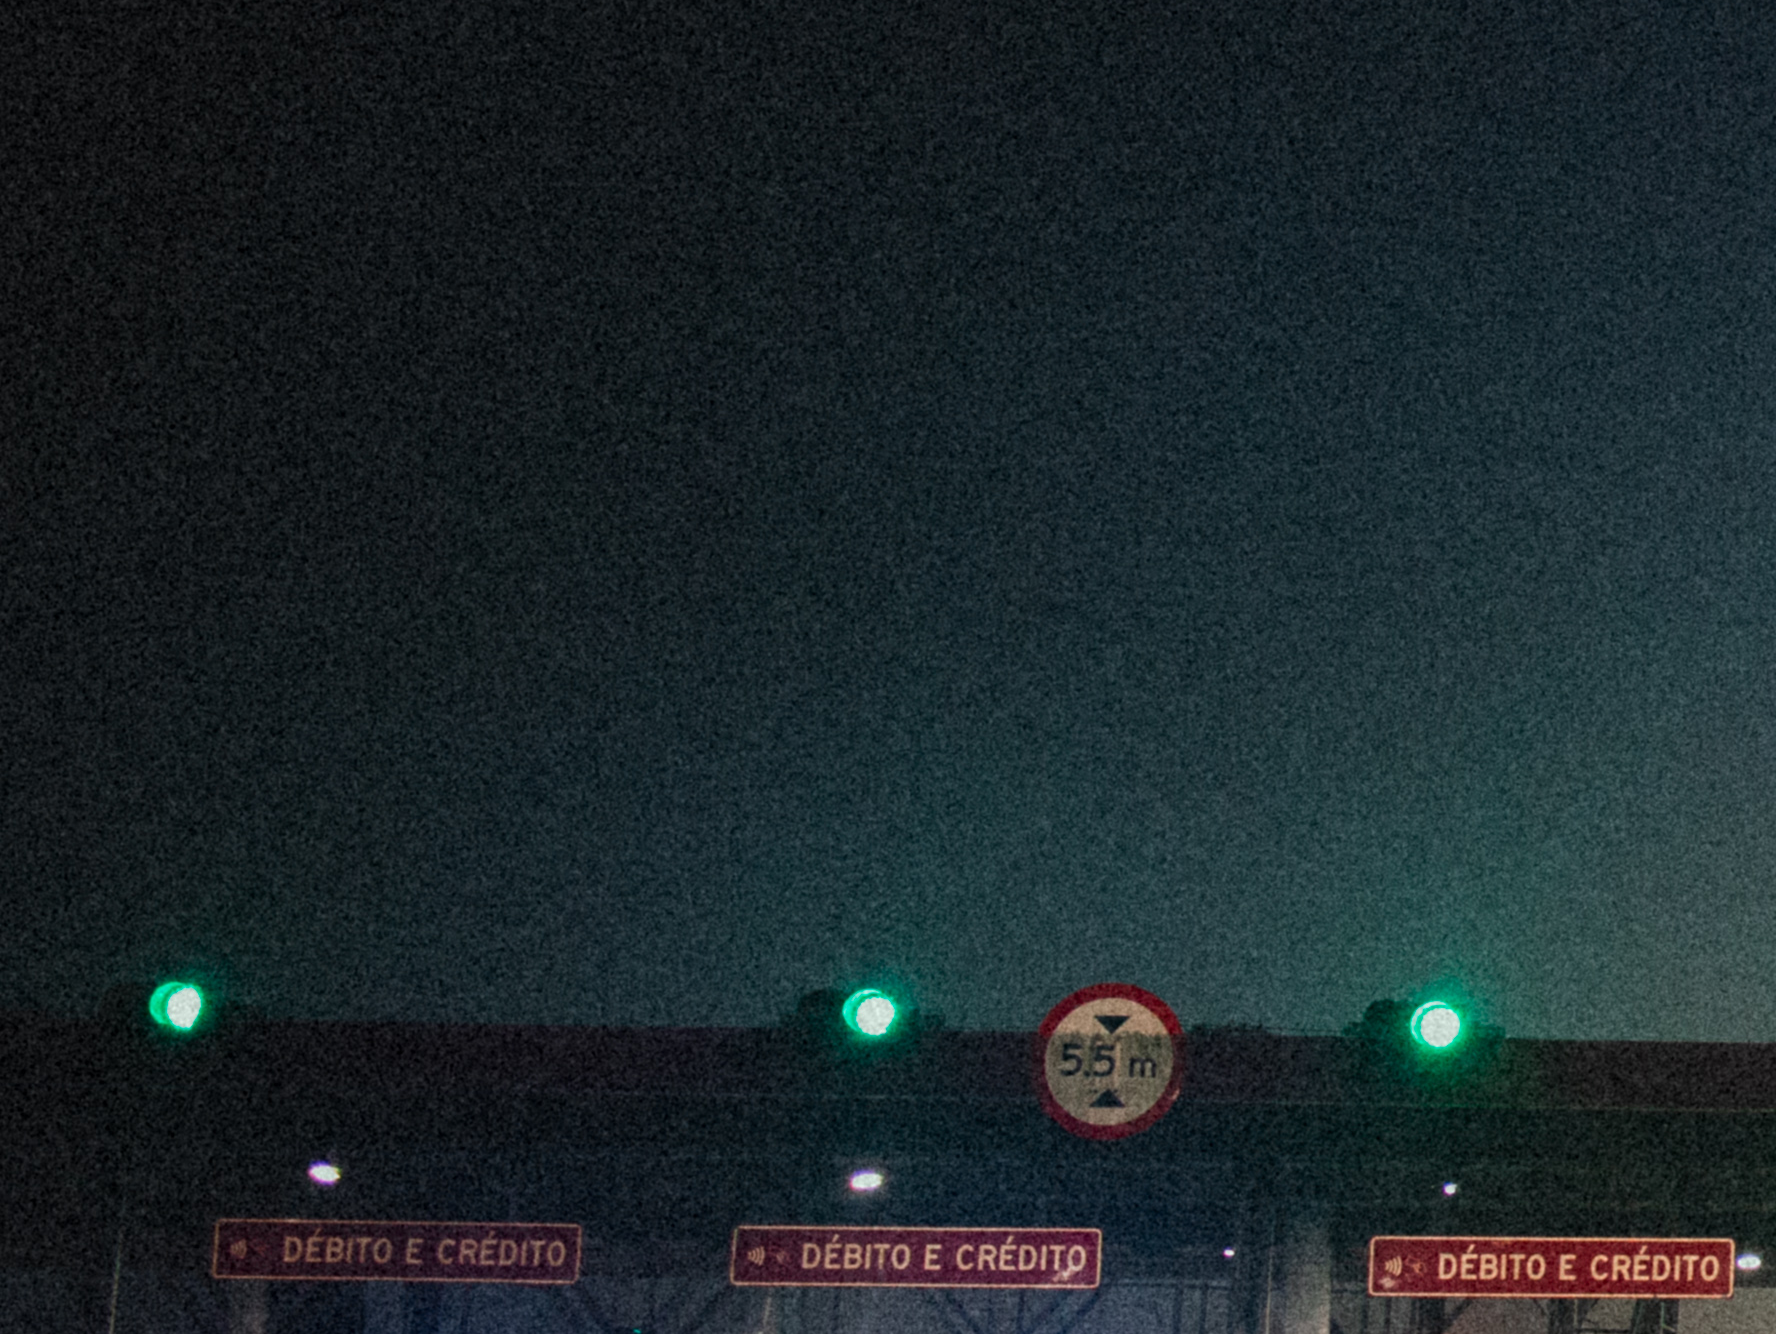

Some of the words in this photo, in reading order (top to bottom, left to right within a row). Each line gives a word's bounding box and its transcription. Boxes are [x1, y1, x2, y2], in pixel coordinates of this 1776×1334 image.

[1129, 1056, 1157, 1078] m
[283, 1228, 392, 1264] DÉBITO
[405, 1238, 423, 1265] E
[437, 1230, 567, 1267] CRÉDITO
[801, 1234, 911, 1269] DÉBITO
[924, 1244, 942, 1269] E
[956, 1236, 1087, 1271] CRÉDITO
[1438, 1244, 1547, 1281] DÉBITO
[1559, 1254, 1577, 1281] E
[1590, 1246, 1721, 1282] CRÉDITO
